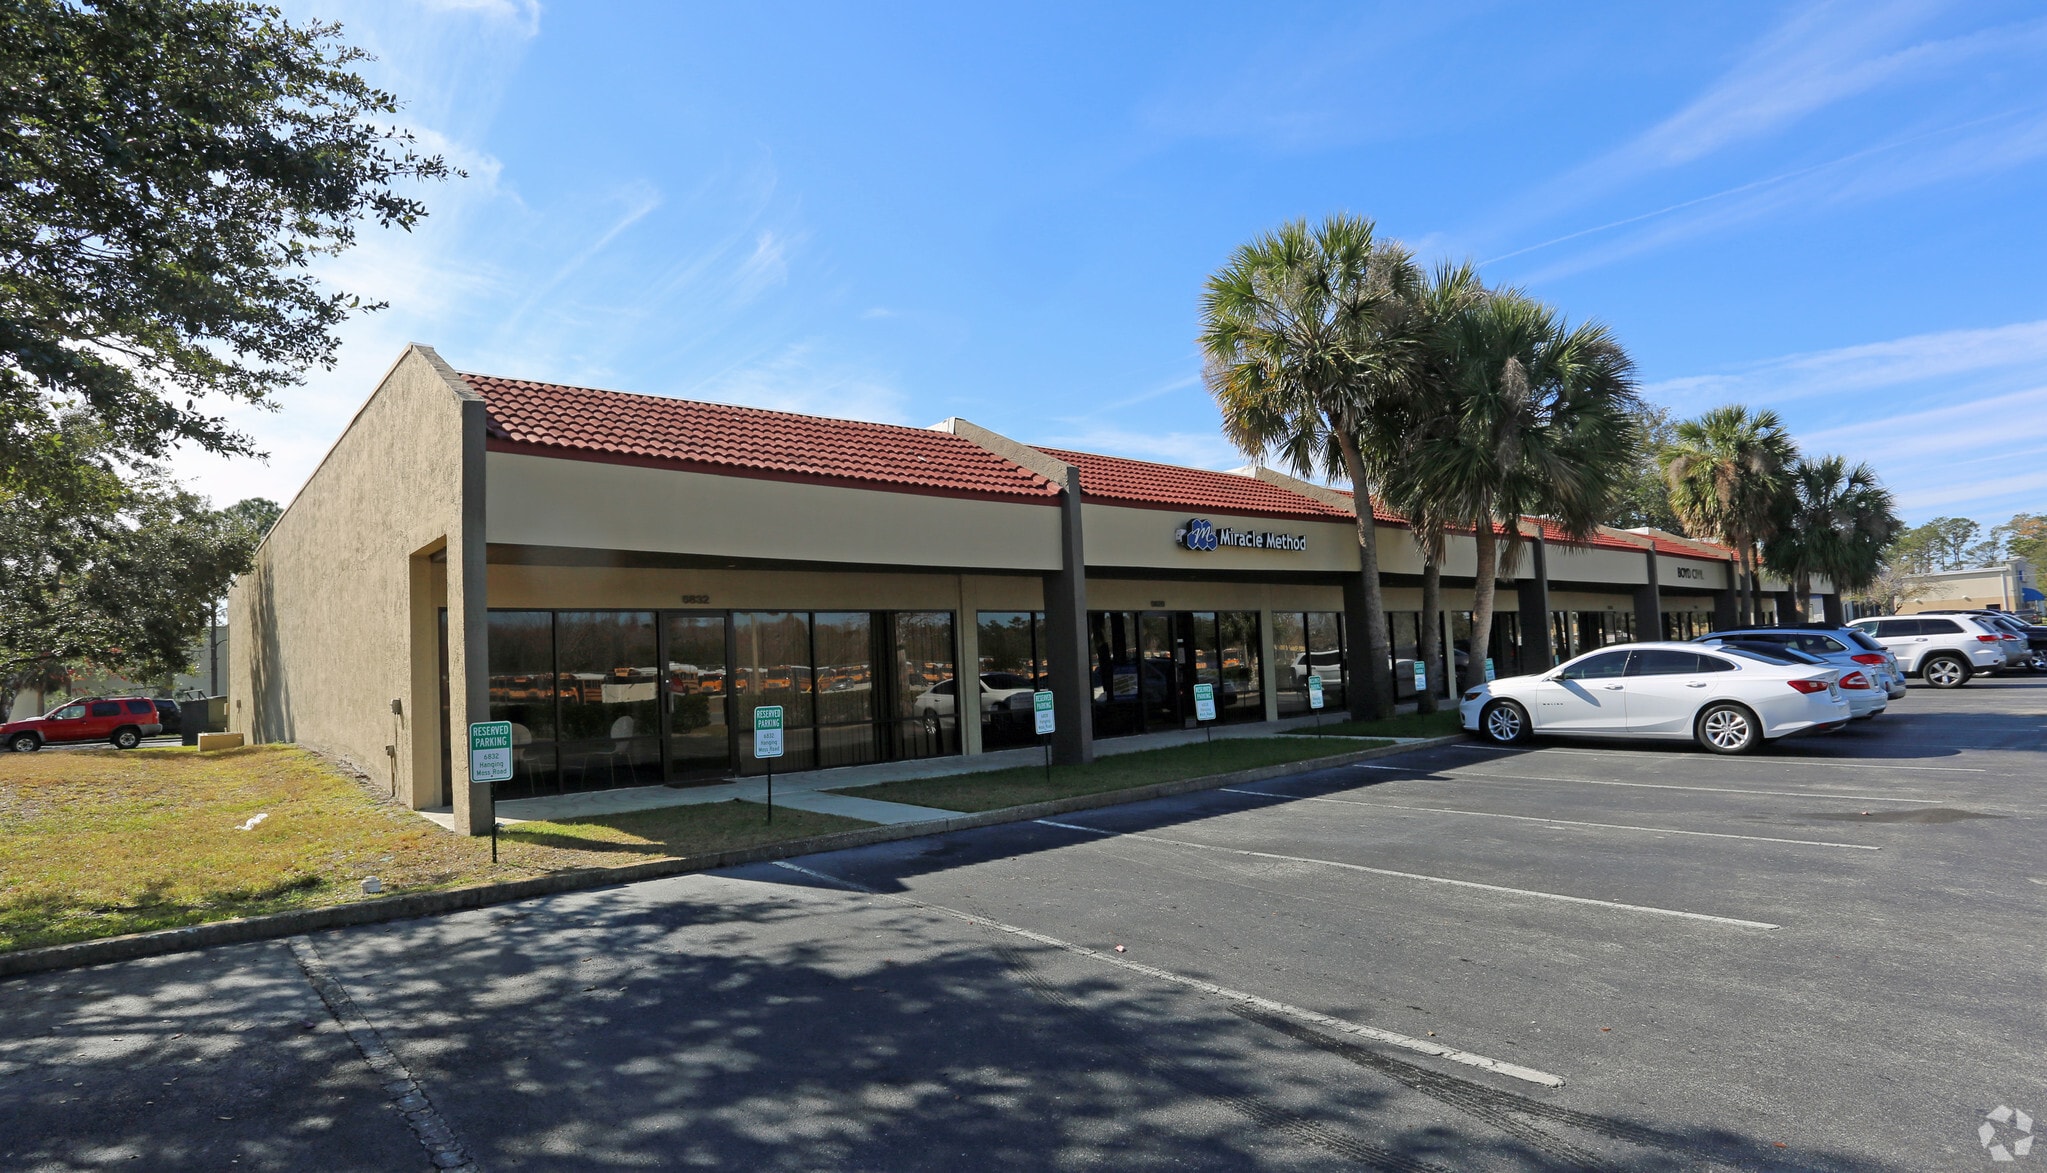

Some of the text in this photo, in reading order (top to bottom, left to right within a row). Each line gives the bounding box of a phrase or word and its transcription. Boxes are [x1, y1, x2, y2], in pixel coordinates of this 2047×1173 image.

[1220, 528, 1263, 547] Miracle
[1266, 533, 1306, 551] Method
[1677, 567, 1691, 579] BOYD
[757, 710, 780, 718] RESERVED
[758, 719, 780, 728] PARKING
[473, 725, 509, 736] RESERVED
[475, 737, 507, 747] PARKING
